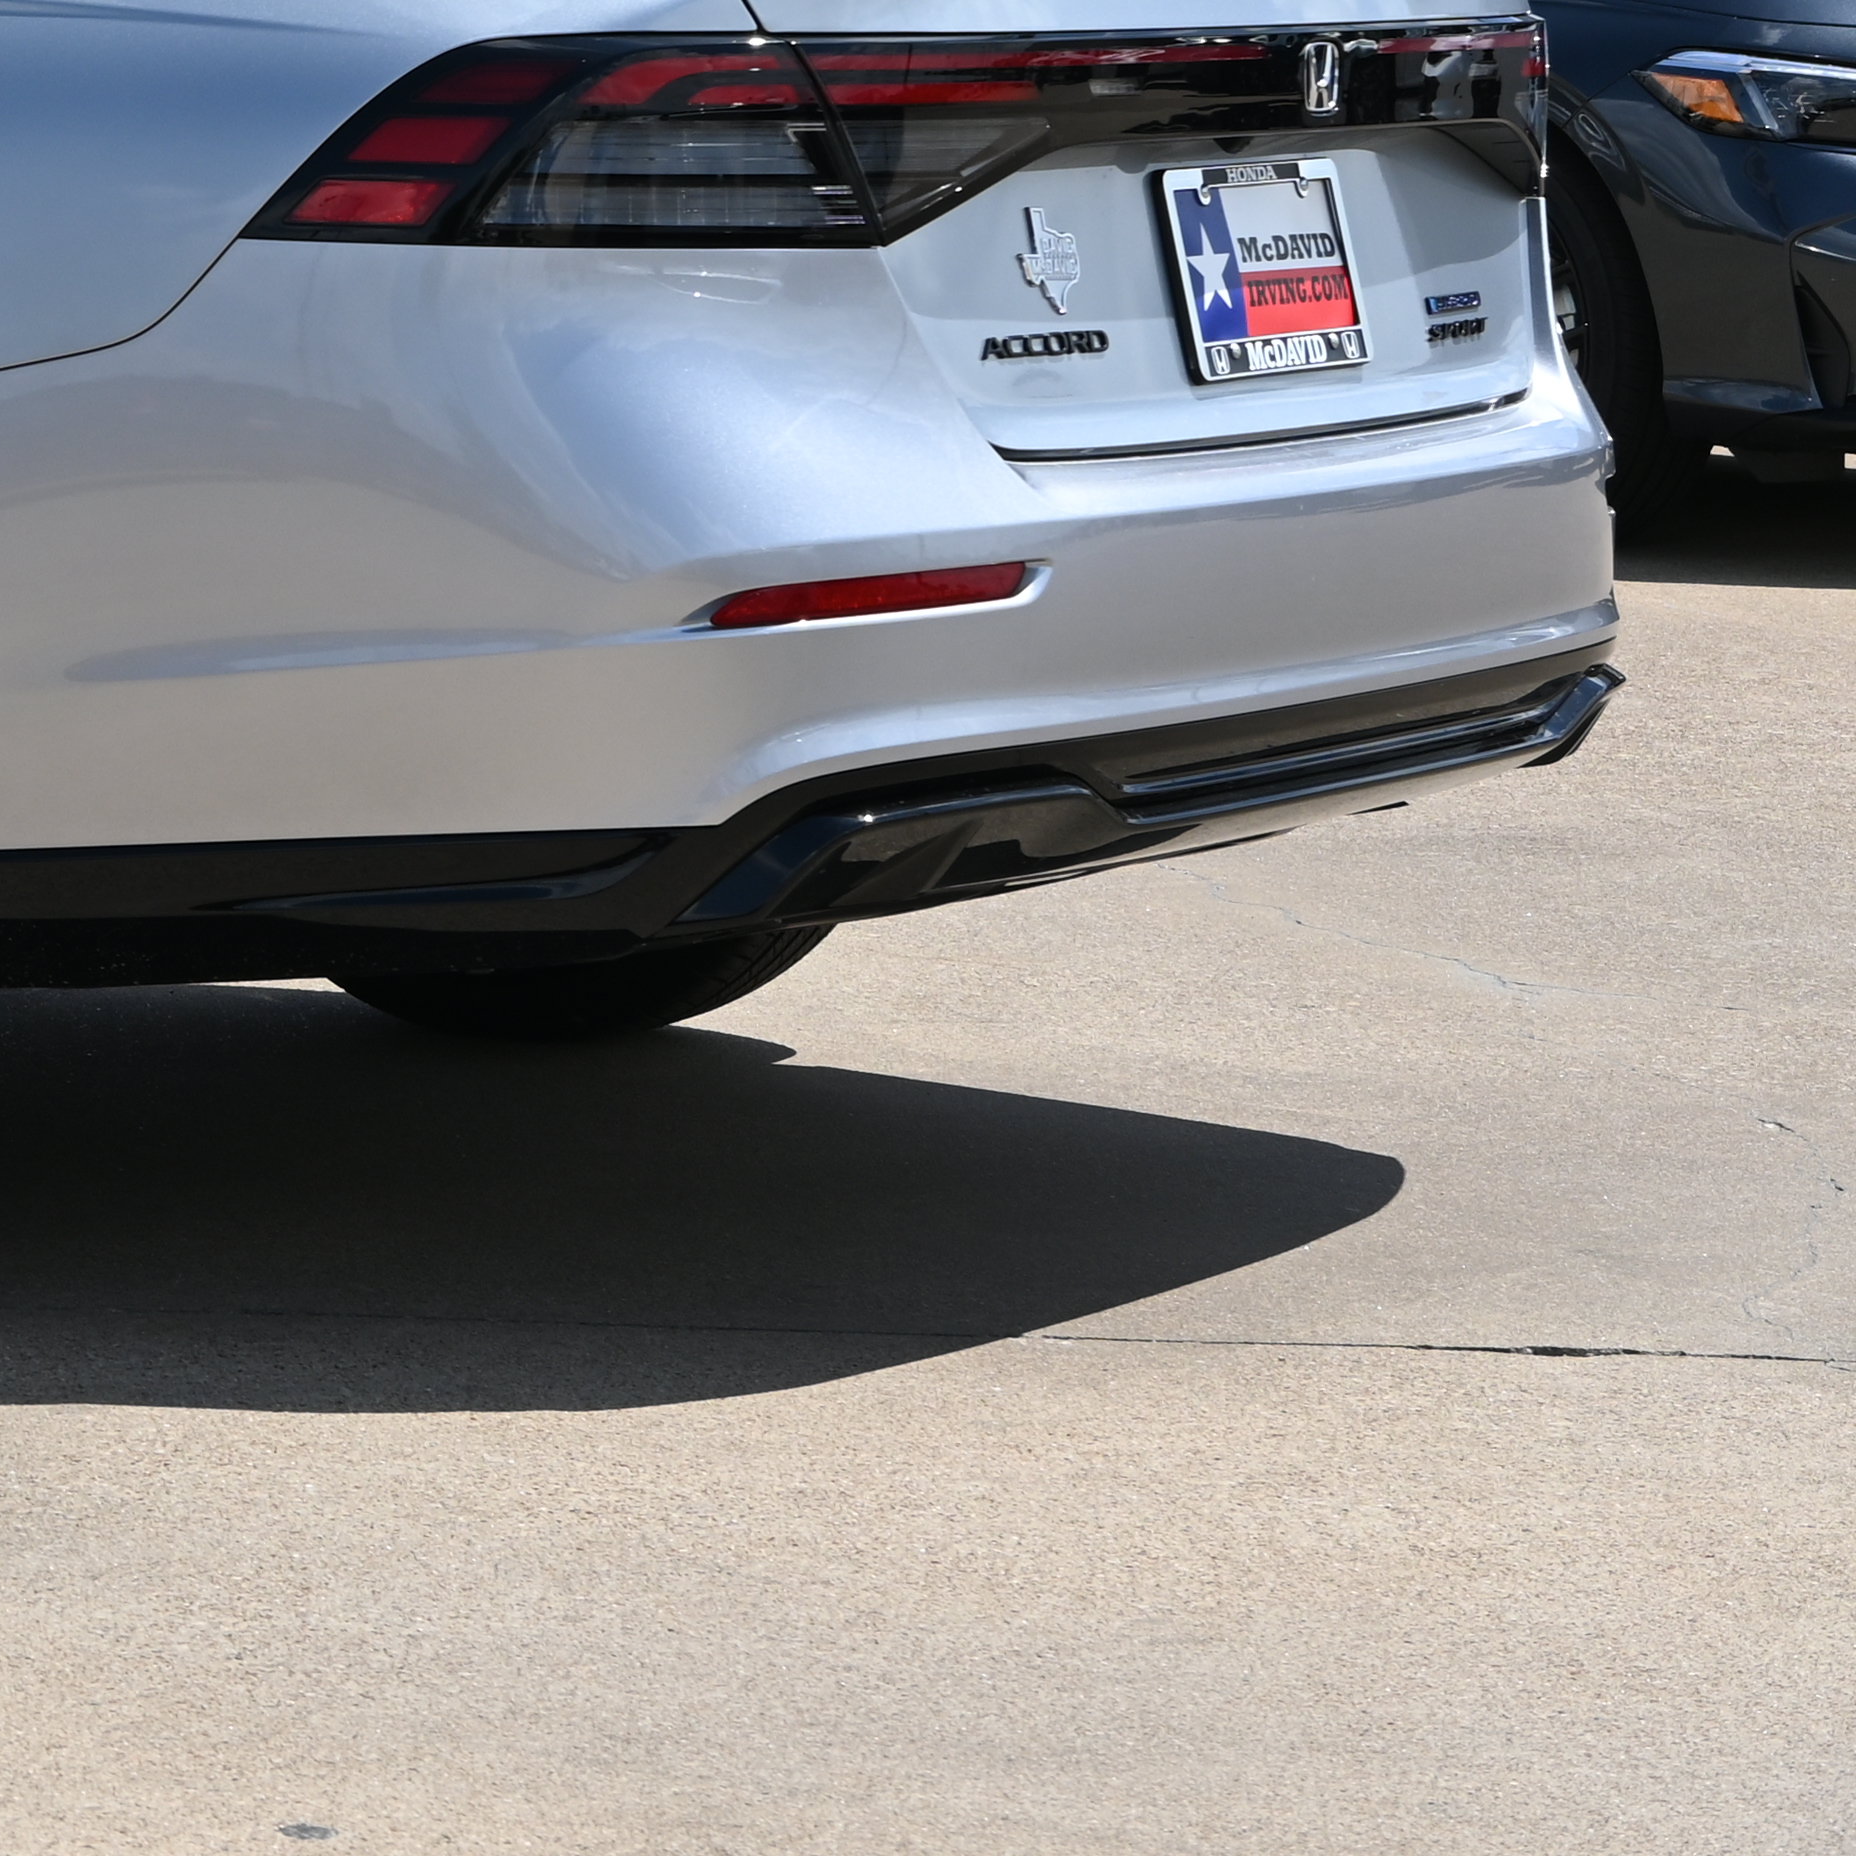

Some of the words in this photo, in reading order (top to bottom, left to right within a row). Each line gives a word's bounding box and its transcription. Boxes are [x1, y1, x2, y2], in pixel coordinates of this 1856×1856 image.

[1225, 166, 1278, 183] HONDA
[1237, 232, 1336, 263] McDAVID
[1247, 273, 1349, 307] IRVING.COM
[980, 329, 1110, 361] ACCORD
[1244, 334, 1328, 370] McDAVID
